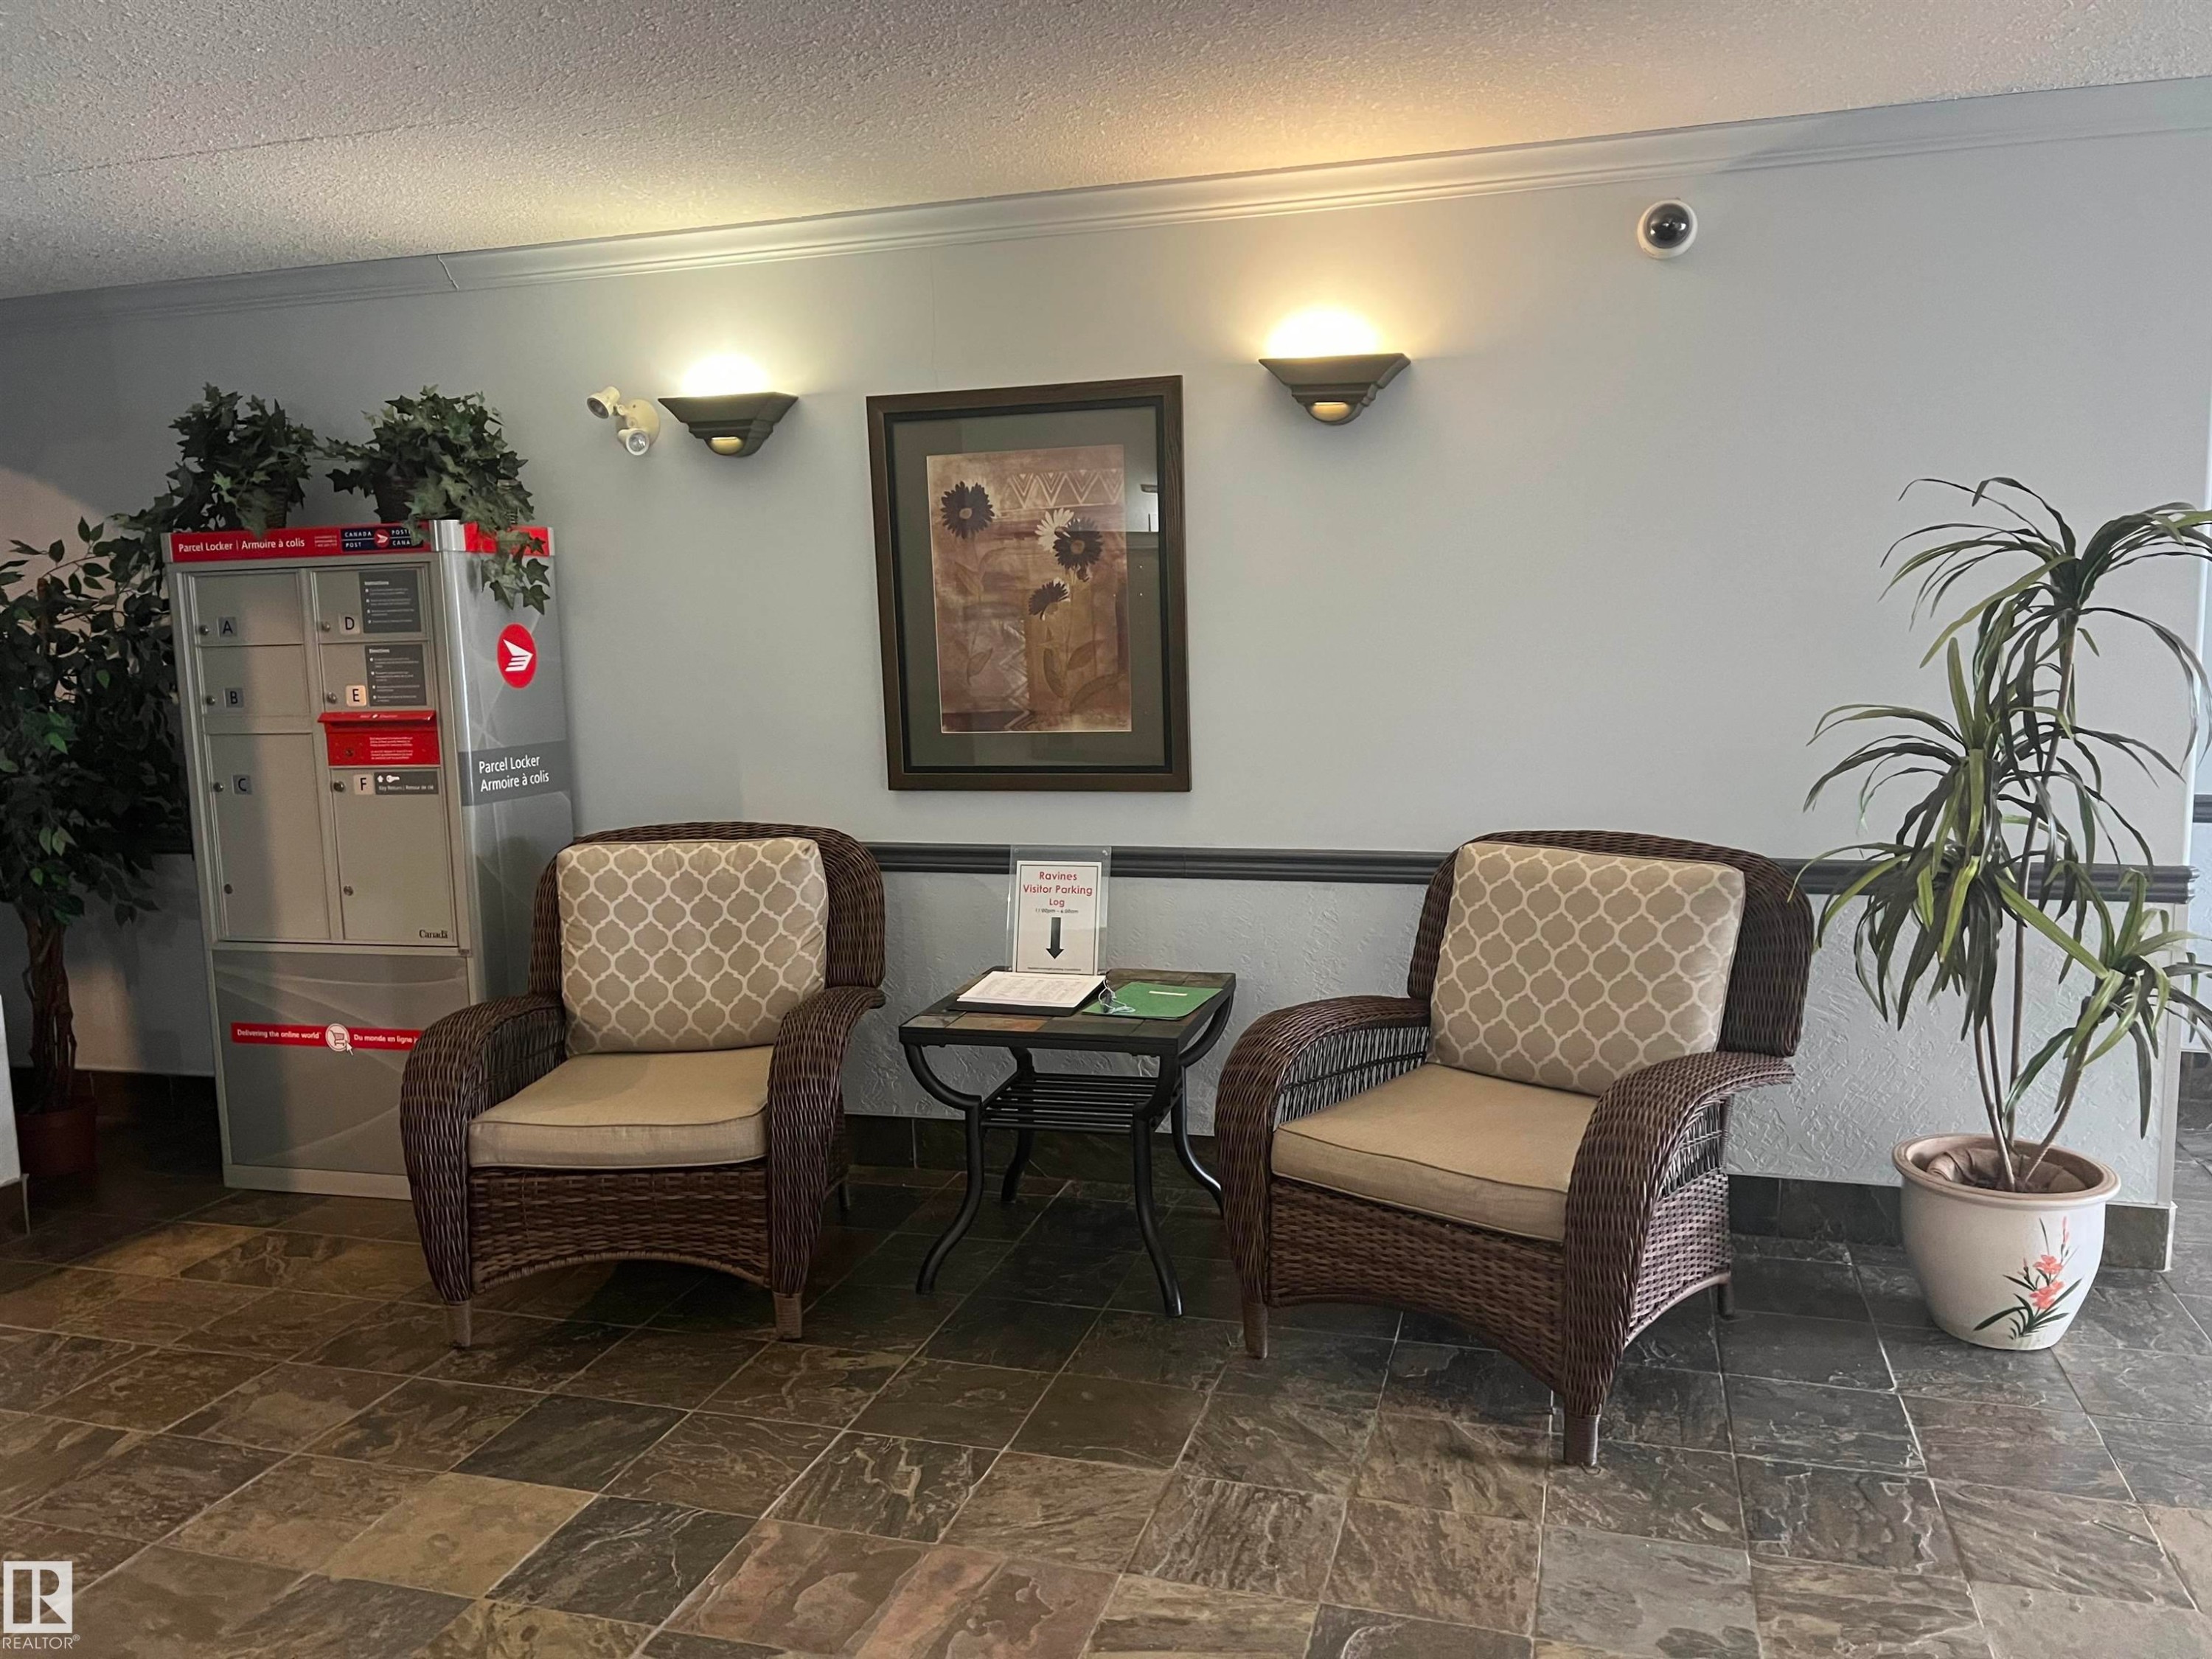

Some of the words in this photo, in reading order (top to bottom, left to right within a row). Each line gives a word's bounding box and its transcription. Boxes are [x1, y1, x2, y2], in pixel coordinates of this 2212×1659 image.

[178, 542, 204, 552] Parcel
[206, 540, 233, 551] Locker
[241, 539, 276, 550] Armoire
[278, 538, 284, 547] à
[285, 538, 305, 547] colis
[223, 620, 233, 634] A
[345, 616, 355, 630] D
[229, 691, 238, 704] B
[352, 689, 360, 702] E
[479, 757, 508, 773] Parcel
[510, 754, 540, 770] Locker
[238, 778, 247, 792] C
[360, 777, 367, 791] F
[480, 775, 520, 792] Armoire
[522, 773, 528, 786] à
[530, 770, 549, 785] colis
[1039, 871, 1077, 880] Ravines
[1023, 884, 1052, 894] Visitor
[1055, 885, 1093, 897] Parking
[1049, 898, 1065, 908] Log
[419, 929, 448, 939] Canada
[237, 1029, 268, 1038] Delivering
[397, 1035, 413, 1044] ligne
